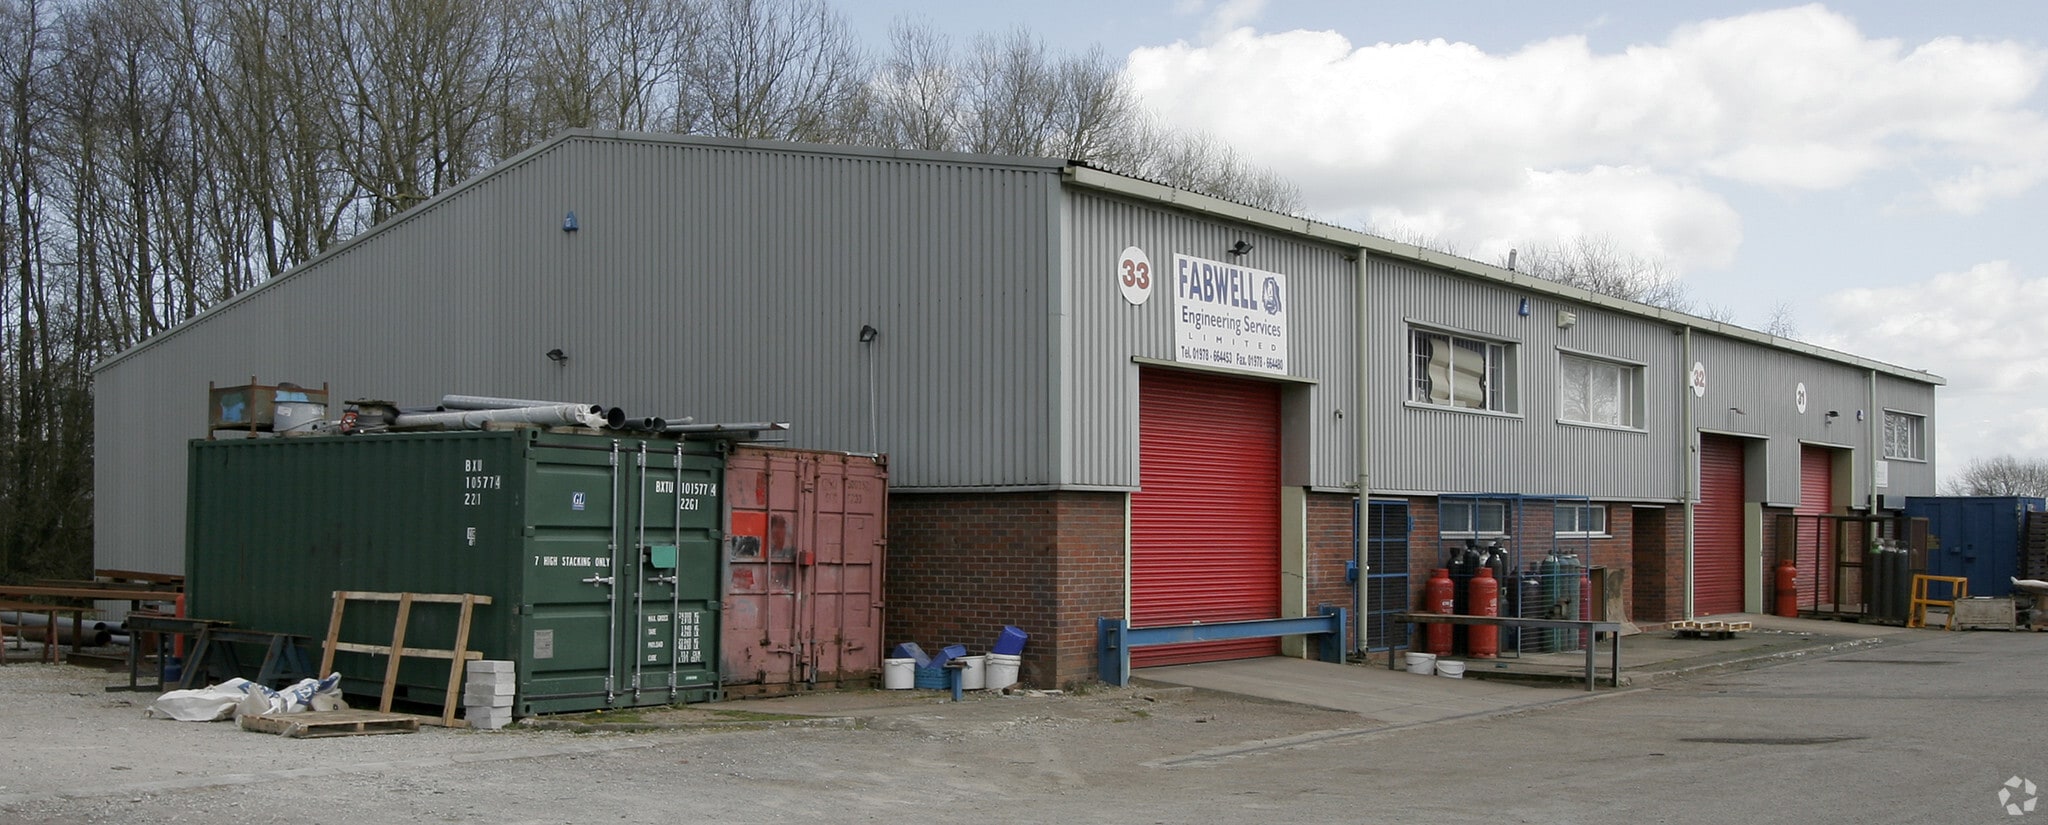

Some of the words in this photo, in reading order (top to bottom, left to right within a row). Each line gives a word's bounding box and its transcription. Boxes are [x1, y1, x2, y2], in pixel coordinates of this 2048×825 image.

[1122, 259, 1150, 290] 33
[1178, 258, 1258, 311] FABWELL
[1182, 305, 1242, 336] Engineering
[1243, 315, 1281, 337] Services
[1188, 332, 1277, 352] LIMITED
[1693, 369, 1705, 388] 32
[1797, 390, 1805, 405] 31
[655, 480, 674, 493] BXTU
[680, 498, 699, 511] 22G1
[534, 556, 540, 566] 7
[543, 556, 558, 566] HIGH
[561, 556, 592, 567] STACKING
[594, 557, 611, 568] ONLY
